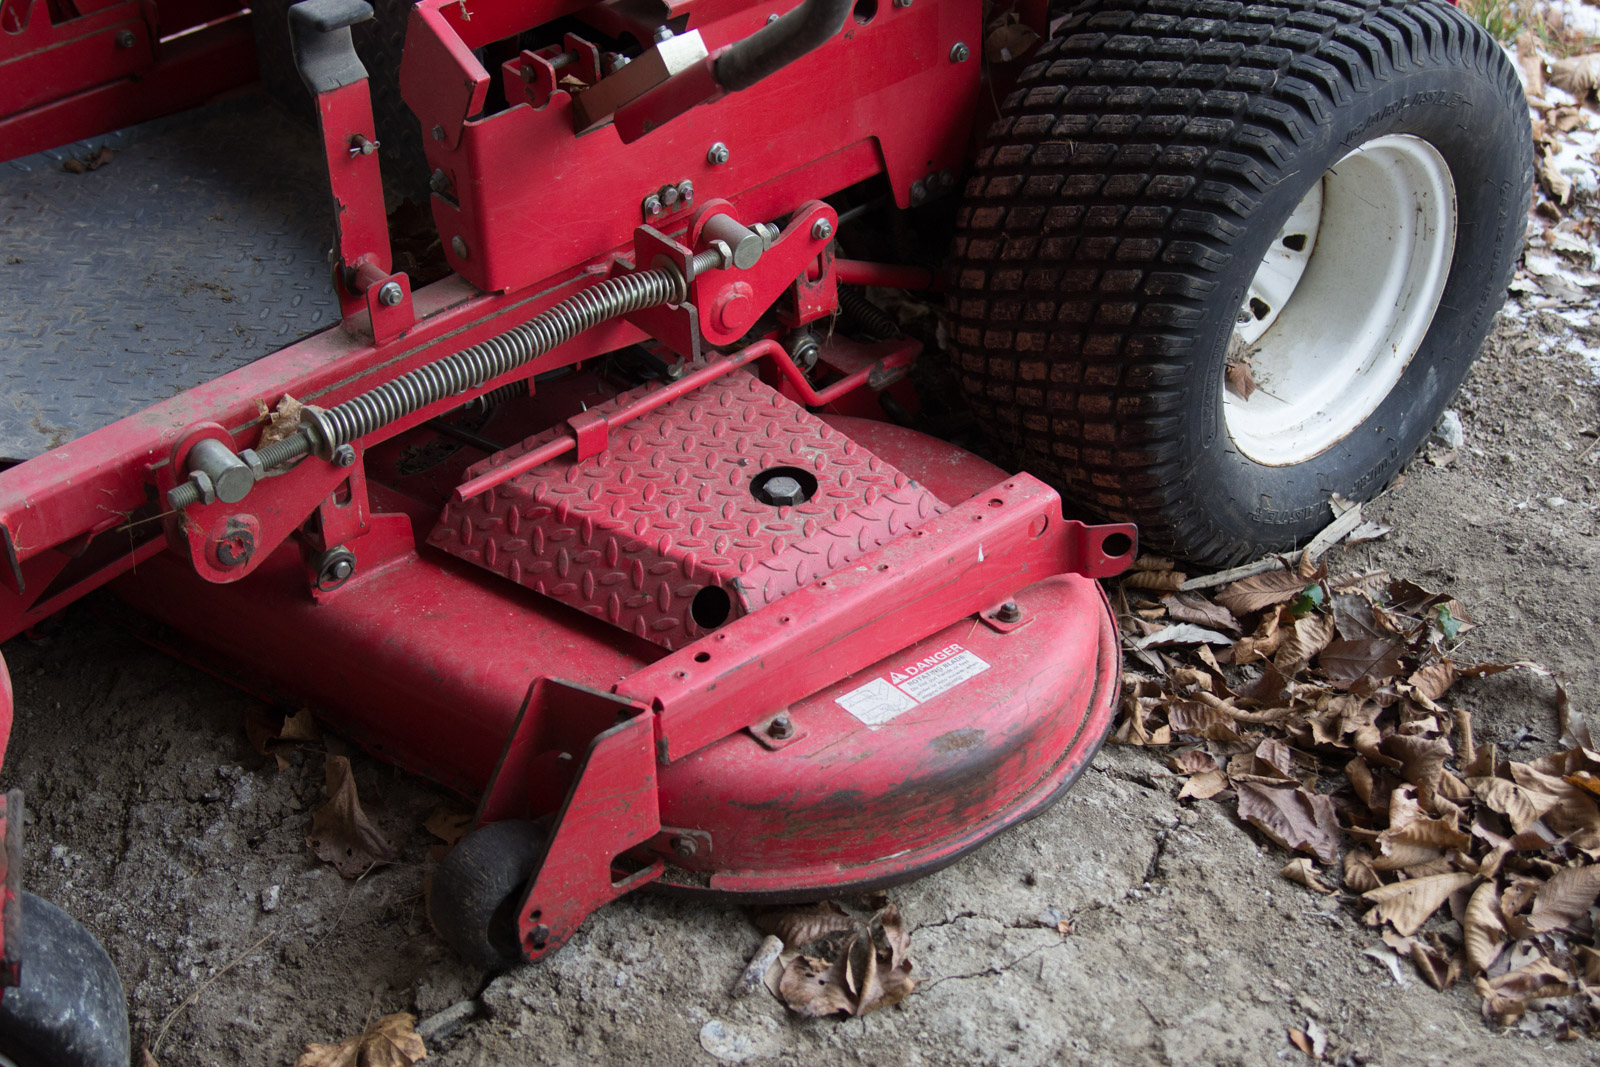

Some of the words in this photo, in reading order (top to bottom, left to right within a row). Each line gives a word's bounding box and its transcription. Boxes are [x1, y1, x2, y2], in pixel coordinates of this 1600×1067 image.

[1344, 89, 1463, 144] CARLISLE
[905, 643, 963, 675] DANGER
[907, 666, 943, 686] ROTATING
[943, 655, 965, 668] BLADE
